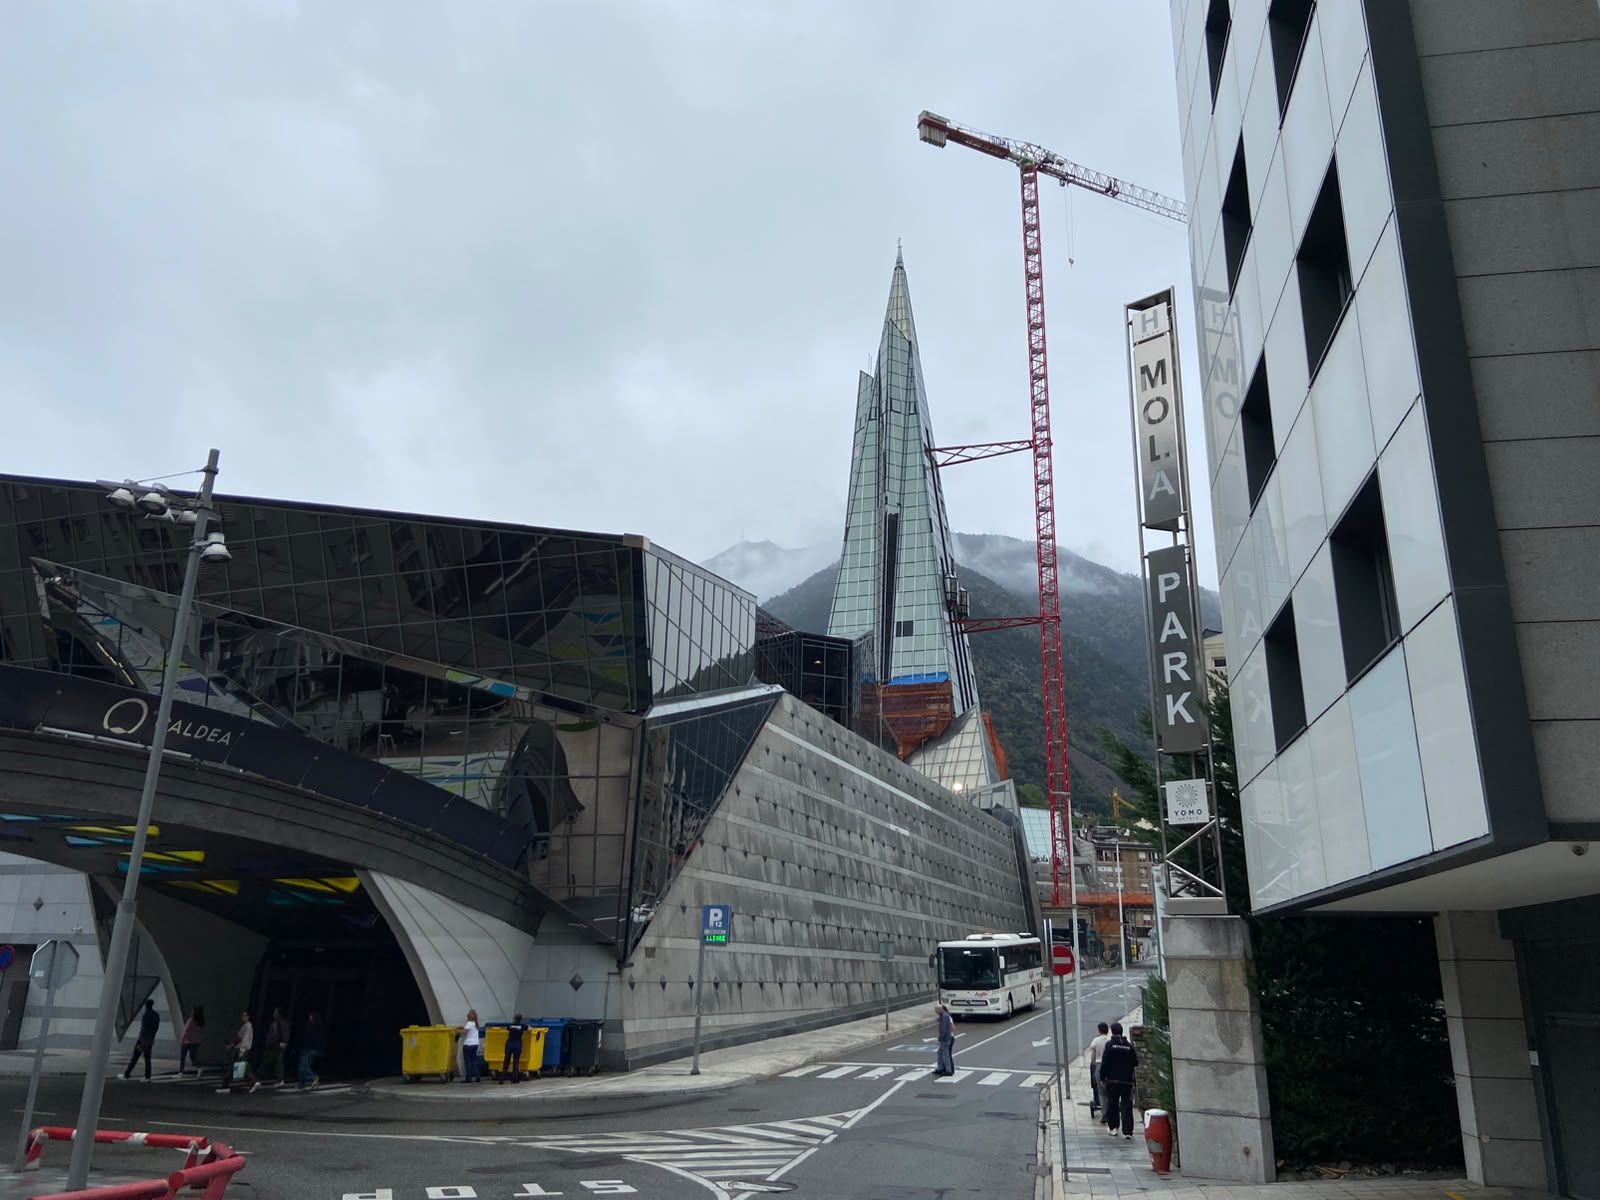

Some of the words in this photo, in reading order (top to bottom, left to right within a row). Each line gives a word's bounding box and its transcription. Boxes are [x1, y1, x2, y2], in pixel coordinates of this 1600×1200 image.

[1141, 309, 1159, 333] H
[1157, 571, 1195, 726] PARK
[156, 717, 231, 746] ALDEA
[1174, 808, 1203, 816] YOMO
[342, 1179, 638, 1200] STOP
